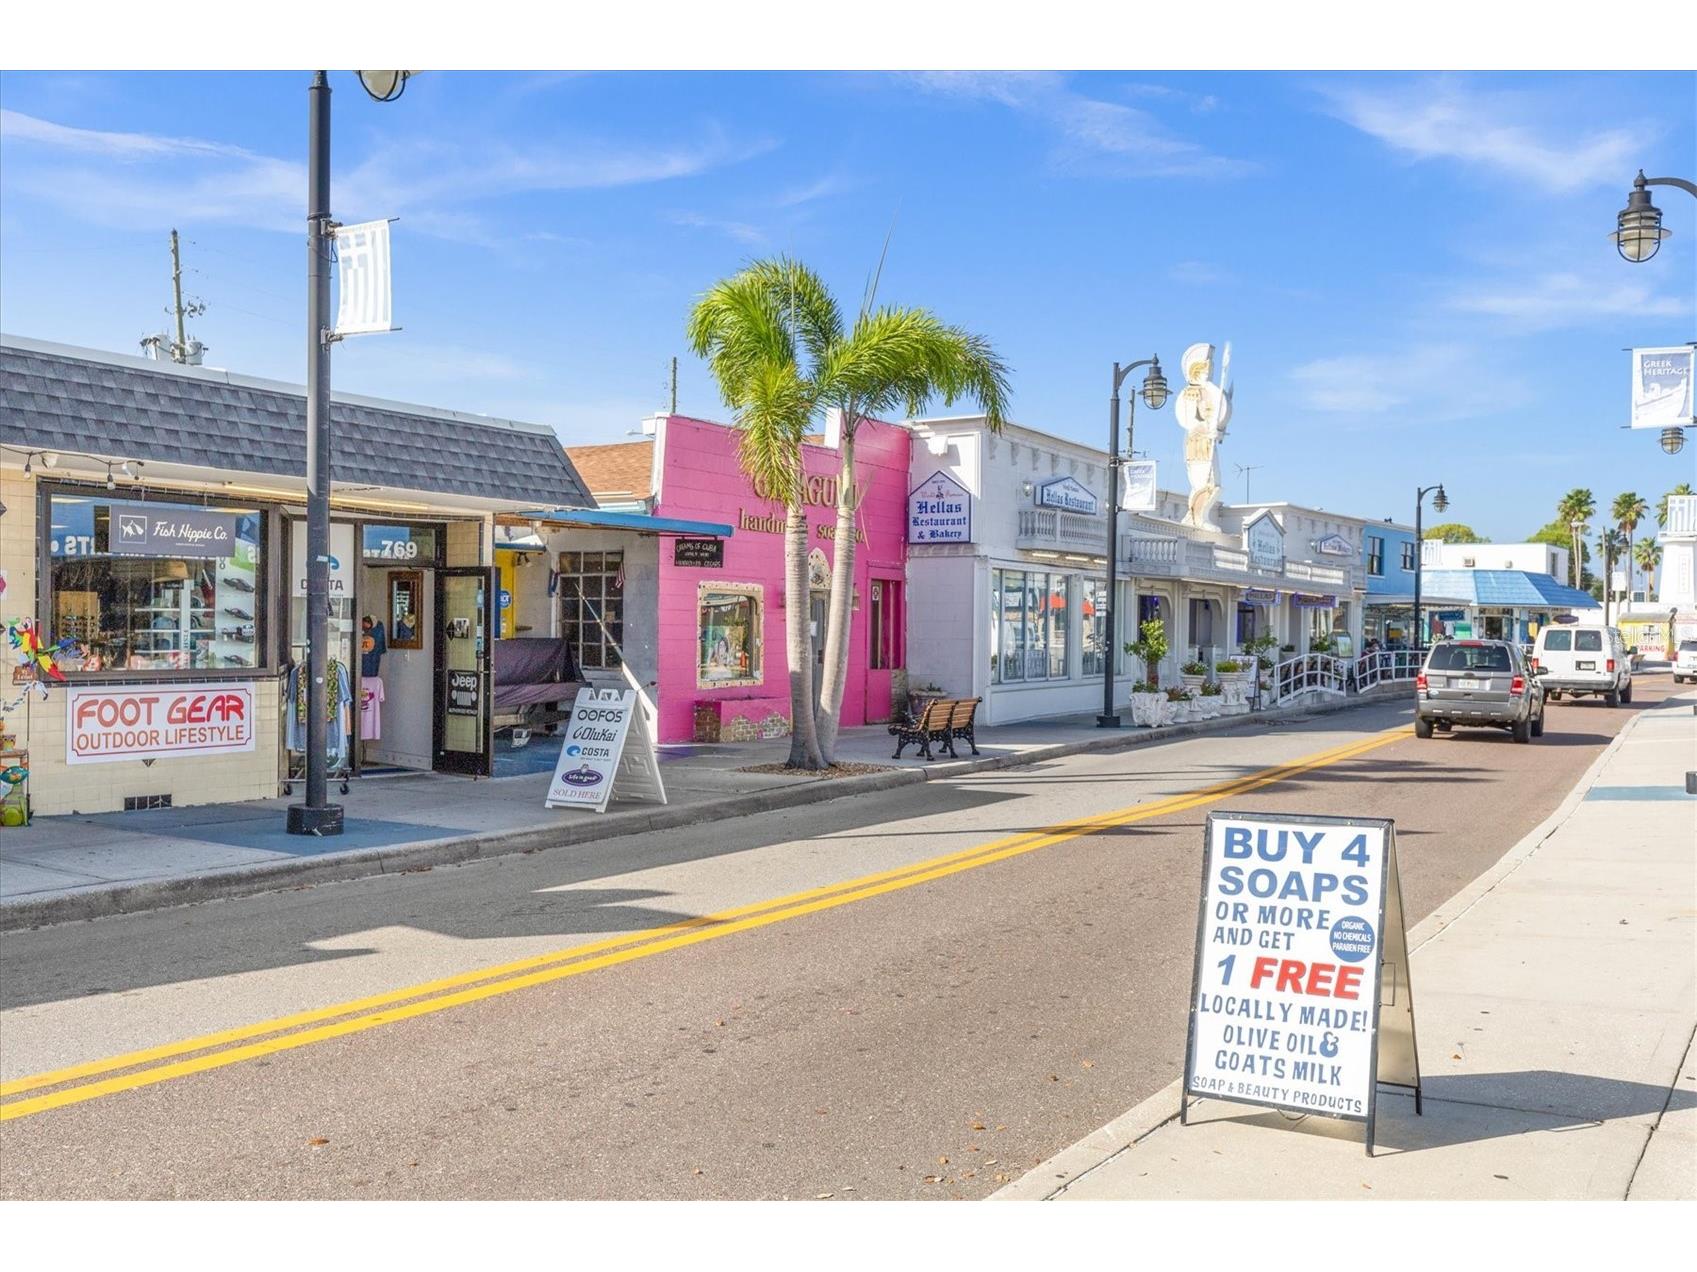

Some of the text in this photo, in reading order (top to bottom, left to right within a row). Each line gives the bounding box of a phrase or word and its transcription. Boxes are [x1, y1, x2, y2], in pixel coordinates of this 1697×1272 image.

[1643, 359, 1672, 368] GREEK
[1643, 367, 1688, 376] HERITAGE
[916, 501, 962, 514] Hellas
[912, 516, 967, 526] Restaurant
[153, 521, 228, 543] Fish Hippie Co.
[917, 529, 962, 540] & Bakery
[381, 540, 418, 558] 769
[300, 578, 344, 590] CTA
[451, 673, 478, 691] Jeep
[77, 694, 245, 729] FOOT GEAR
[577, 709, 623, 723] OOFOS
[76, 725, 244, 750] OUTDOOR LIFESTYLE
[580, 727, 618, 742] OluKai
[581, 747, 609, 757] COSTA
[553, 788, 601, 800] SOLD HERE
[1223, 827, 1370, 867] BUY 4
[1217, 866, 1369, 906] SOAPS
[1215, 901, 1331, 930] OR MORE
[1341, 920, 1365, 931] ORGANIC
[1212, 926, 1295, 951] AND GET
[1333, 931, 1372, 943] NO CHEMICALS
[1332, 942, 1371, 954] PARABEN FREE
[1217, 954, 1364, 1001] 1 FREE
[1200, 992, 1368, 1033] LOCALLY MADE!
[1223, 1024, 1280, 1050] OLIVE
[1215, 1050, 1342, 1087] GOATS MILK
[1192, 1075, 1362, 1113] SOAP & BEAUTY PRODUCTS
